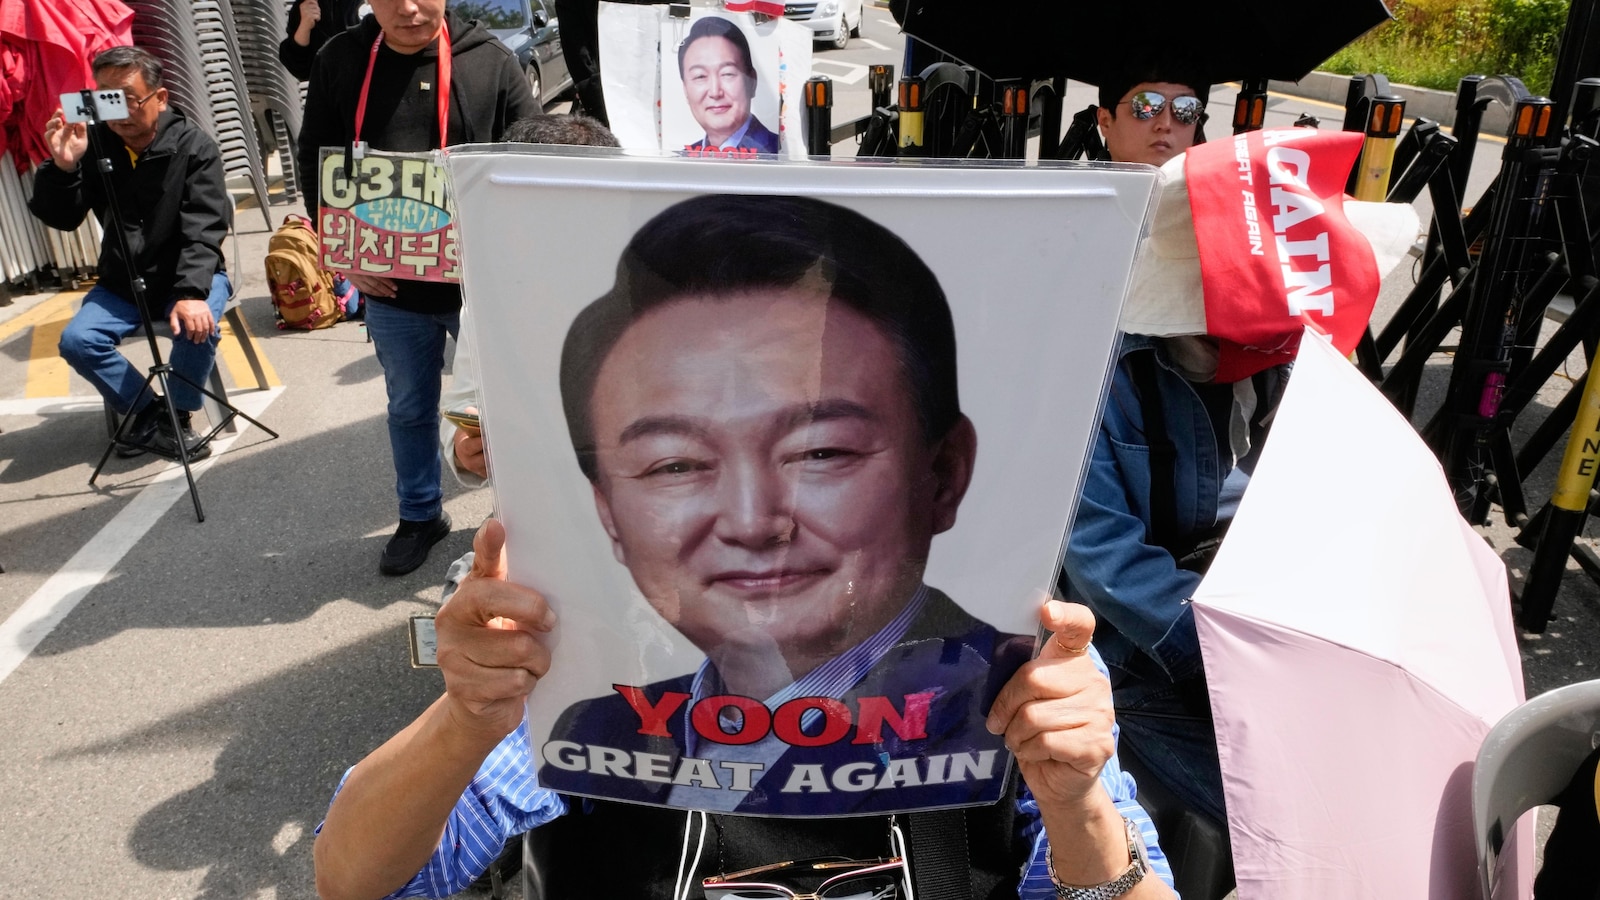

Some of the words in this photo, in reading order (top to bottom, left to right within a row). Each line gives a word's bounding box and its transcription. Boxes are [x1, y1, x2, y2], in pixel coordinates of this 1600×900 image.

[684, 145, 758, 159] YOON
[1242, 190, 1264, 256] AGAIN
[612, 683, 936, 747] YOON
[542, 740, 765, 792] GREAT
[780, 749, 999, 793] AGAIN
